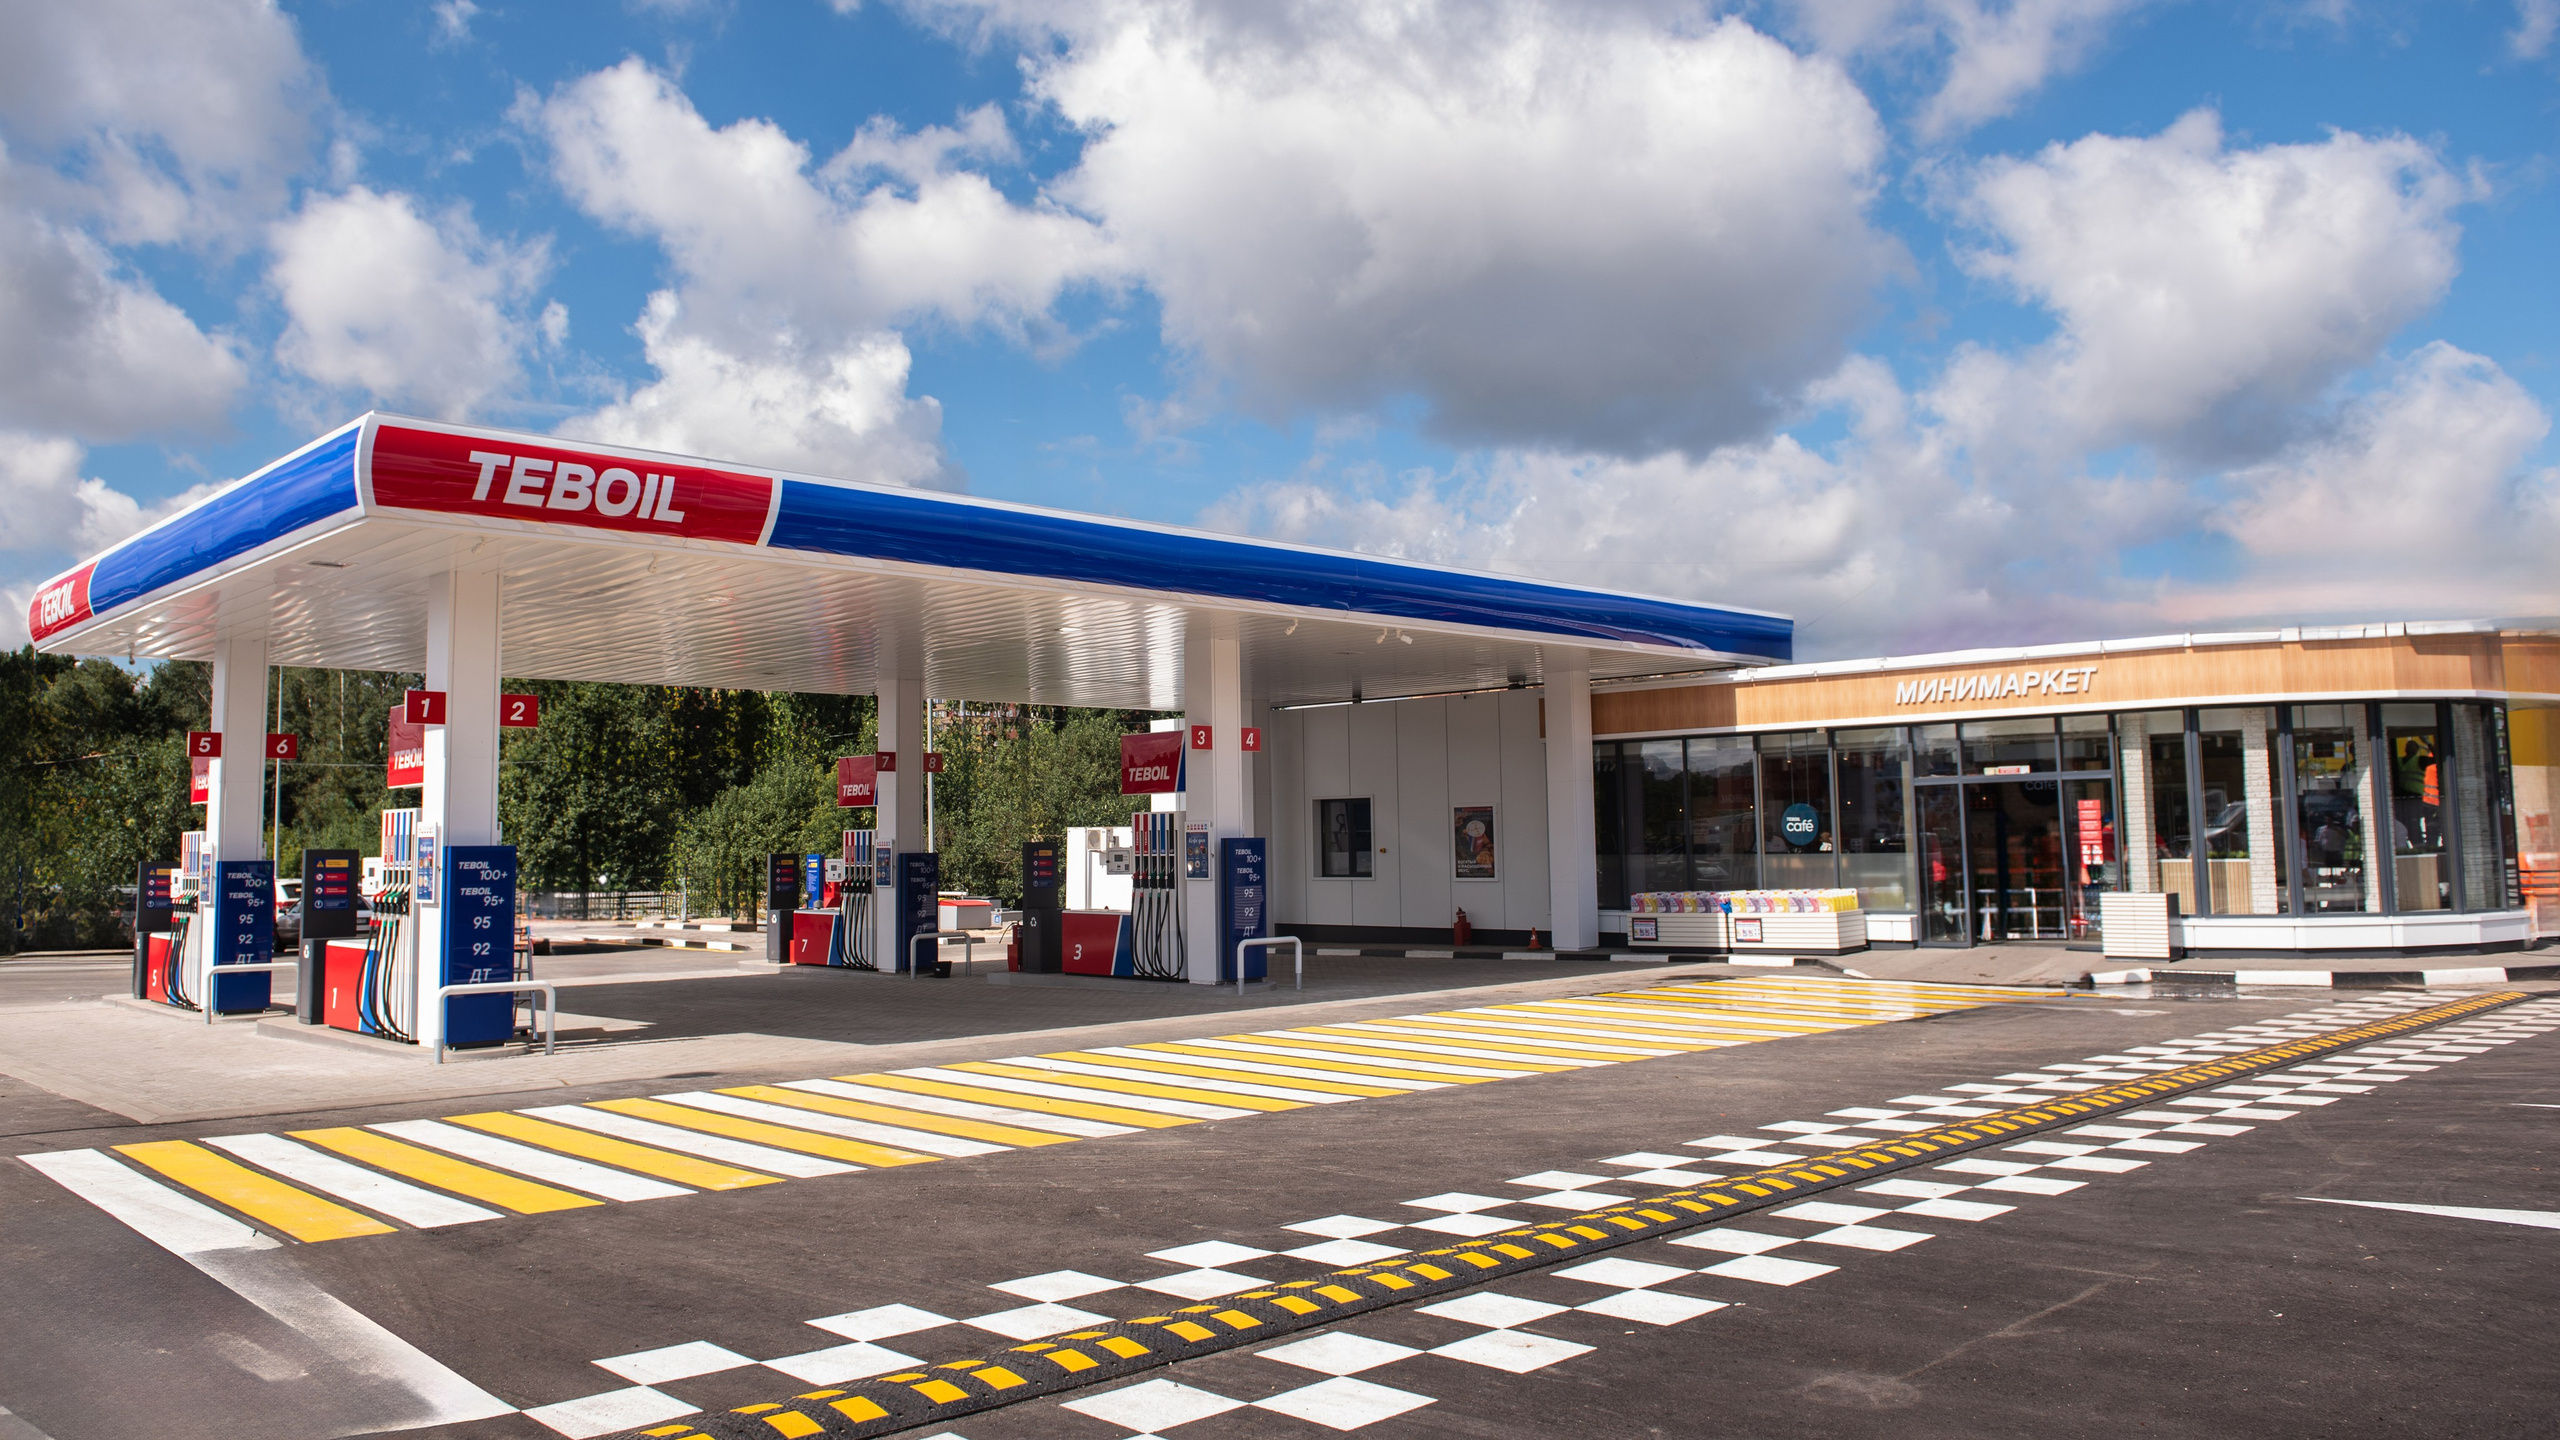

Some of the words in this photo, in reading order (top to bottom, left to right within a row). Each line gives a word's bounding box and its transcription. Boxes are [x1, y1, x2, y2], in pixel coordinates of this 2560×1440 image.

[469, 450, 685, 523] TEBOIL
[41, 580, 75, 628] TEBOIL
[1895, 667, 2098, 706] МИНИМАРКЕТ
[421, 698, 430, 718] 1
[510, 702, 525, 721] 2
[1197, 730, 1206, 745] 3
[1246, 732, 1254, 747] 4
[199, 737, 212, 753] 5
[276, 739, 288, 754] 6
[394, 748, 424, 770] TEBOIL
[881, 756, 889, 769] 7
[928, 757, 936, 769] 8
[1128, 765, 1170, 782] TEBOIL
[194, 775, 209, 790] TEBO
[842, 783, 871, 797] TEBOIL
[1786, 819, 1814, 832] café
[458, 861, 490, 870] TEBOIL
[1246, 855, 1261, 863] 100+
[480, 870, 508, 880] 100+
[244, 879, 268, 887] 100+
[460, 887, 492, 895] TEBOIL
[1244, 889, 1254, 897] 95
[247, 899, 265, 907] 95+
[483, 896, 505, 906] 95+
[917, 894, 927, 902] 95
[917, 910, 927, 918] 92
[1244, 907, 1254, 916] 92
[238, 914, 254, 924] 95
[473, 916, 491, 929] 95
[916, 925, 928, 934] ДТ
[1243, 926, 1256, 937] ДТ
[238, 934, 253, 944] 92
[472, 942, 491, 956] 92
[801, 939, 808, 953] 7
[1073, 944, 1082, 960] 3
[235, 953, 254, 965] ДТ
[152, 969, 157, 987] 5
[469, 968, 492, 984] ДТ
[332, 987, 337, 1009] 1
